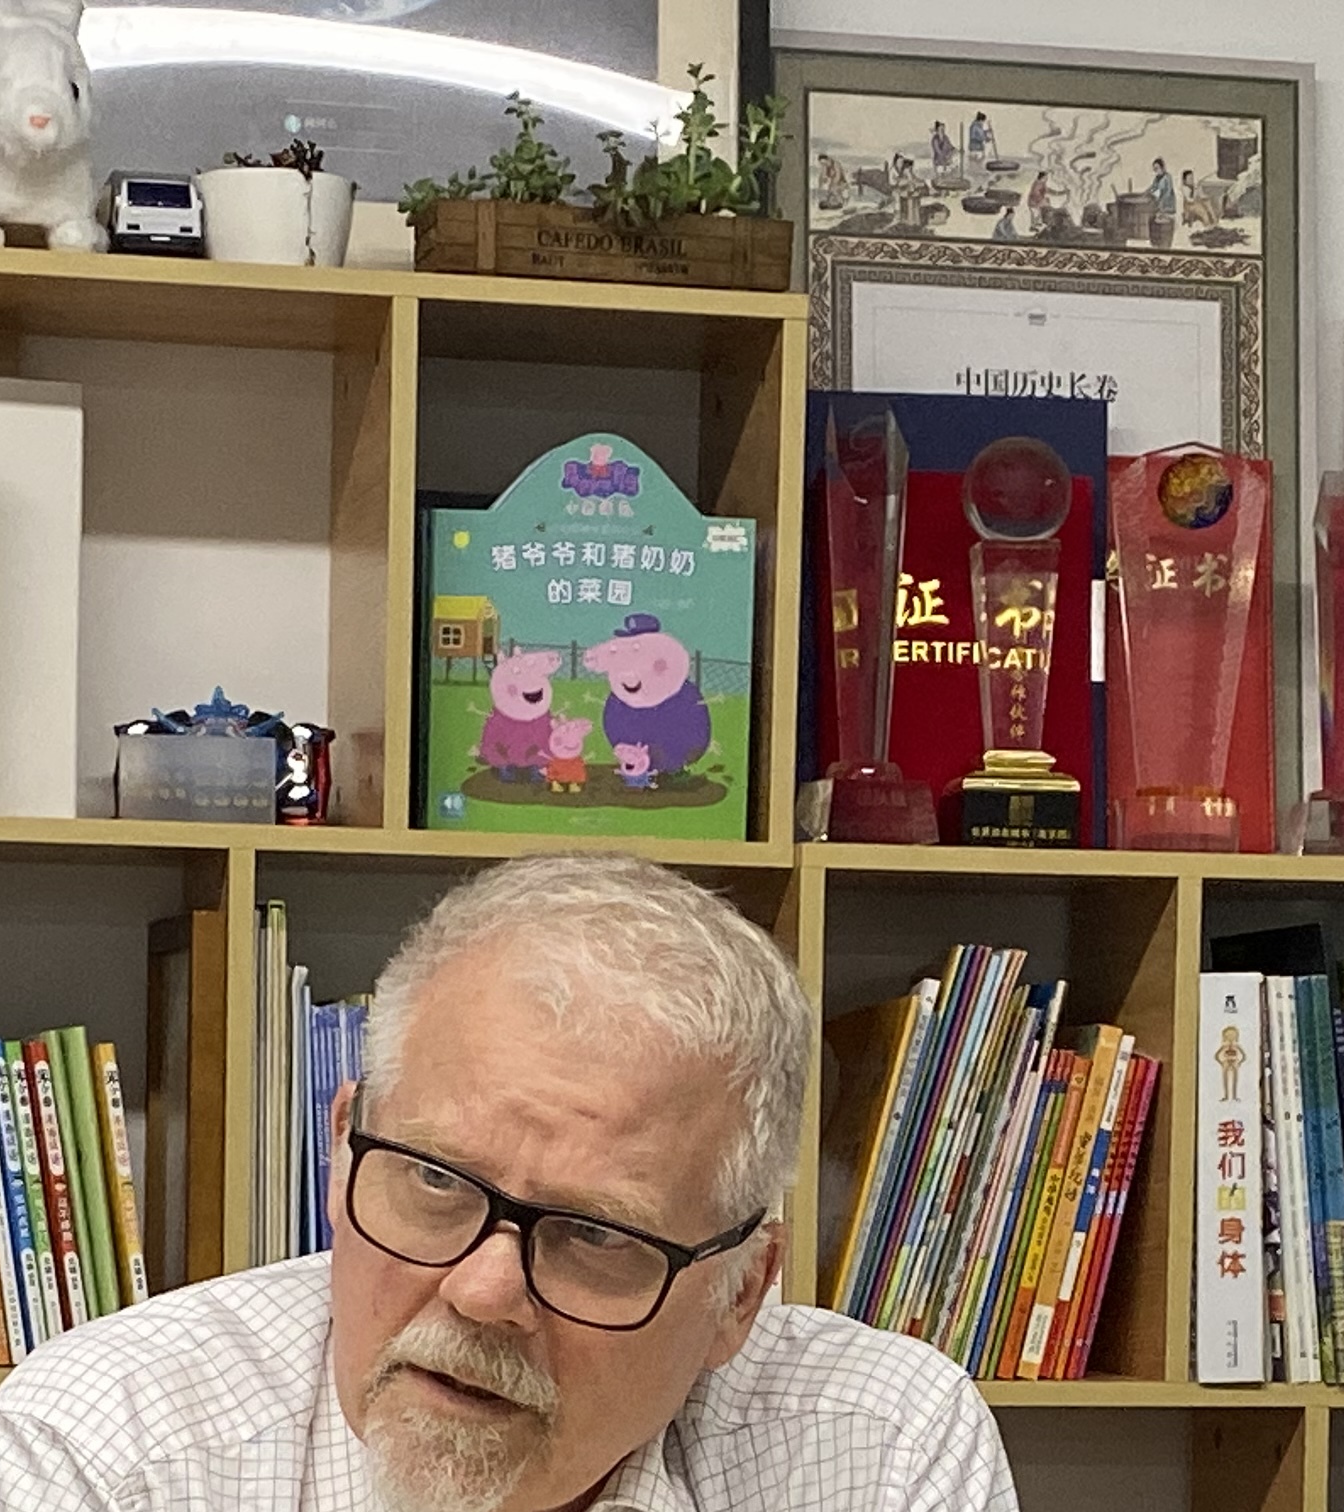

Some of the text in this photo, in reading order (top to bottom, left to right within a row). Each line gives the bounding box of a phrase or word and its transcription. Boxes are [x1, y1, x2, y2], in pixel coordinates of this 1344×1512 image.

[956, 366, 1119, 402] 中国历史长卷
[490, 542, 696, 577] 猪爷爷和猪奶奶
[547, 578, 633, 606] 的菜园
